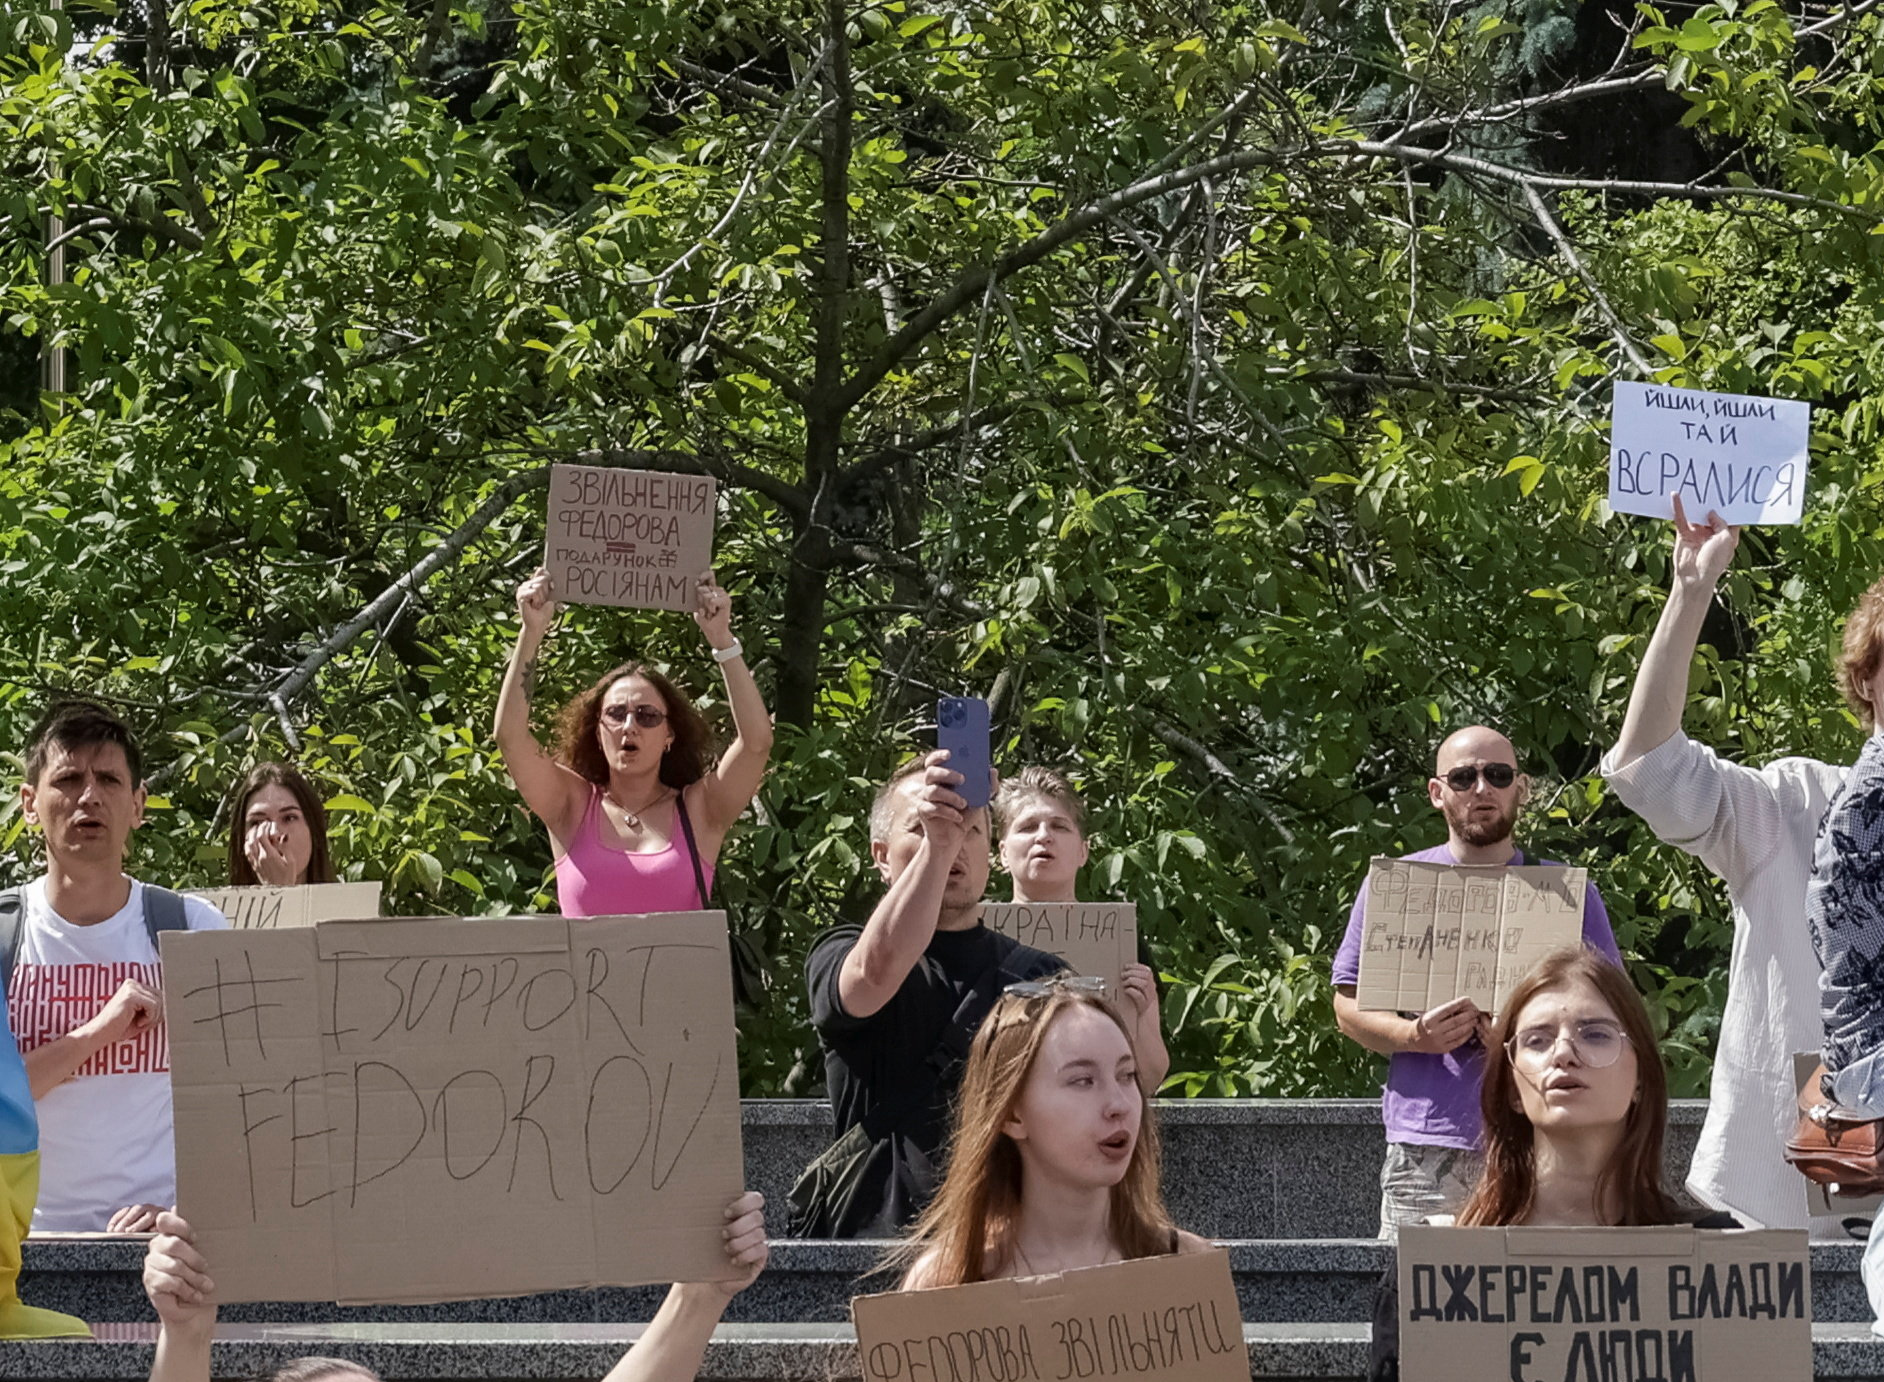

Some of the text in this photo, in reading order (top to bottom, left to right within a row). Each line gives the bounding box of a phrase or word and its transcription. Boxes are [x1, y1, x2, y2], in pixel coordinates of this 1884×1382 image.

[1645, 390, 1776, 421] ЙШЛИ, ЙШЛИ
[1680, 421, 1738, 446] ТА Й
[562, 470, 709, 515] ЗВІЛЬНЕННЯ
[1617, 448, 1795, 507] ВСРАЛИСЯ
[558, 510, 681, 546] ФЕДОРОВА
[556, 549, 657, 568] ПОДАРУНОК
[566, 566, 688, 604] РОСІЯНАМ
[213, 889, 284, 929] НІЙ
[237, 1052, 722, 1223] FEDOROV
[1410, 1261, 1805, 1324] ДЖЕРЕЛОМ ВЛАДИ
[1051, 1300, 1237, 1381] ЗВІЛЬНЯТИ
